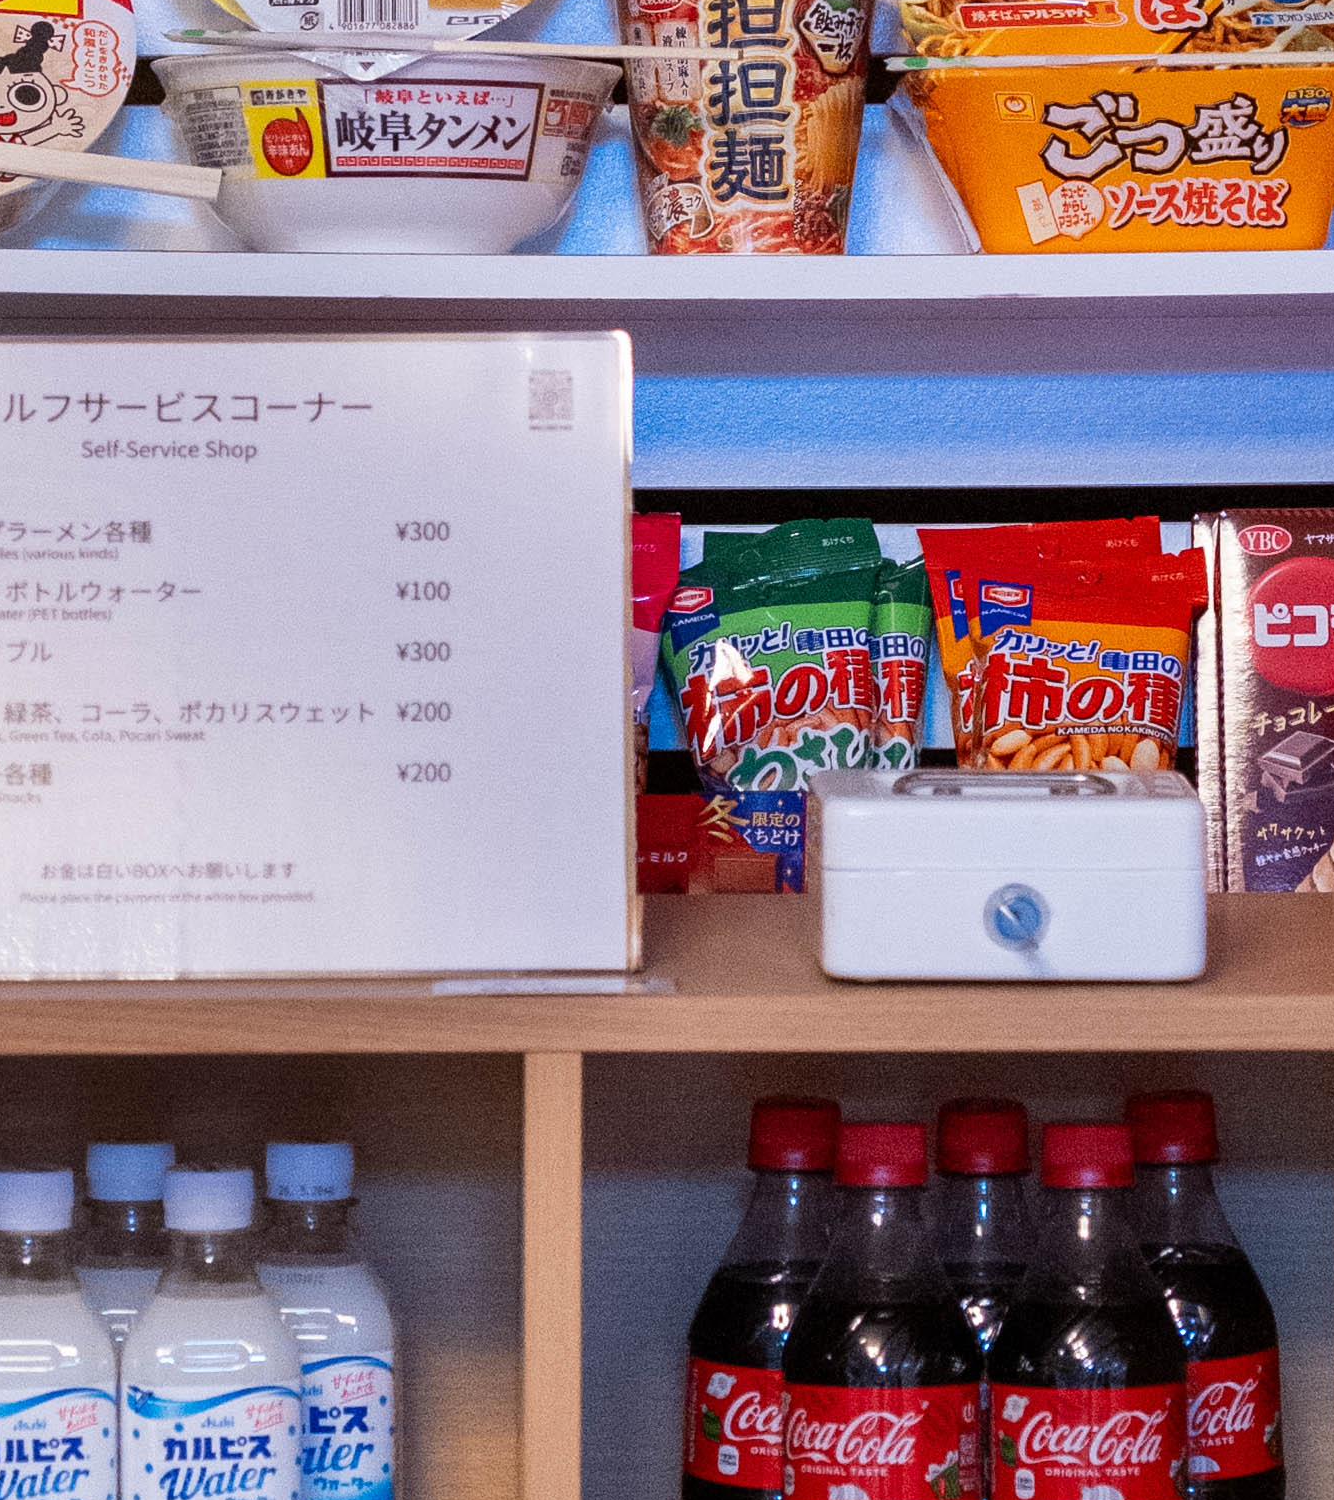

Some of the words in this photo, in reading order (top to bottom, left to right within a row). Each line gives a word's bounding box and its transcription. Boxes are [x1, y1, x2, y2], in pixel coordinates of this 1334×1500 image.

[341, 21, 378, 31] 901677
[1278, 14, 1302, 22] TOYO
[84, 27, 97, 91] 和風とんこつ
[336, 110, 531, 153] 岐阜タンメン
[1062, 200, 1088, 212] からし
[1110, 181, 1285, 224] ソース焼そば
[82, 439, 200, 460] Self-Service
[206, 439, 258, 464] Shop
[396, 521, 450, 542] ¥300
[1245, 530, 1286, 551] YBC
[396, 581, 451, 602] ¥100
[397, 641, 452, 662] ¥300
[993, 628, 1100, 663] カリッと!
[1100, 651, 1182, 677] 亀田の
[978, 653, 1184, 736] 柿の種
[397, 702, 452, 722] ¥200
[397, 762, 452, 782] ¥200
[696, 794, 750, 844] 冬
[752, 812, 801, 826] 限定の
[743, 830, 800, 846] くちどけ
[650, 852, 688, 862] ミルク
[1019, 1407, 1167, 1465] Coca-Cola
[163, 1435, 272, 1461] カルピス
[159, 1465, 277, 1500] Water
